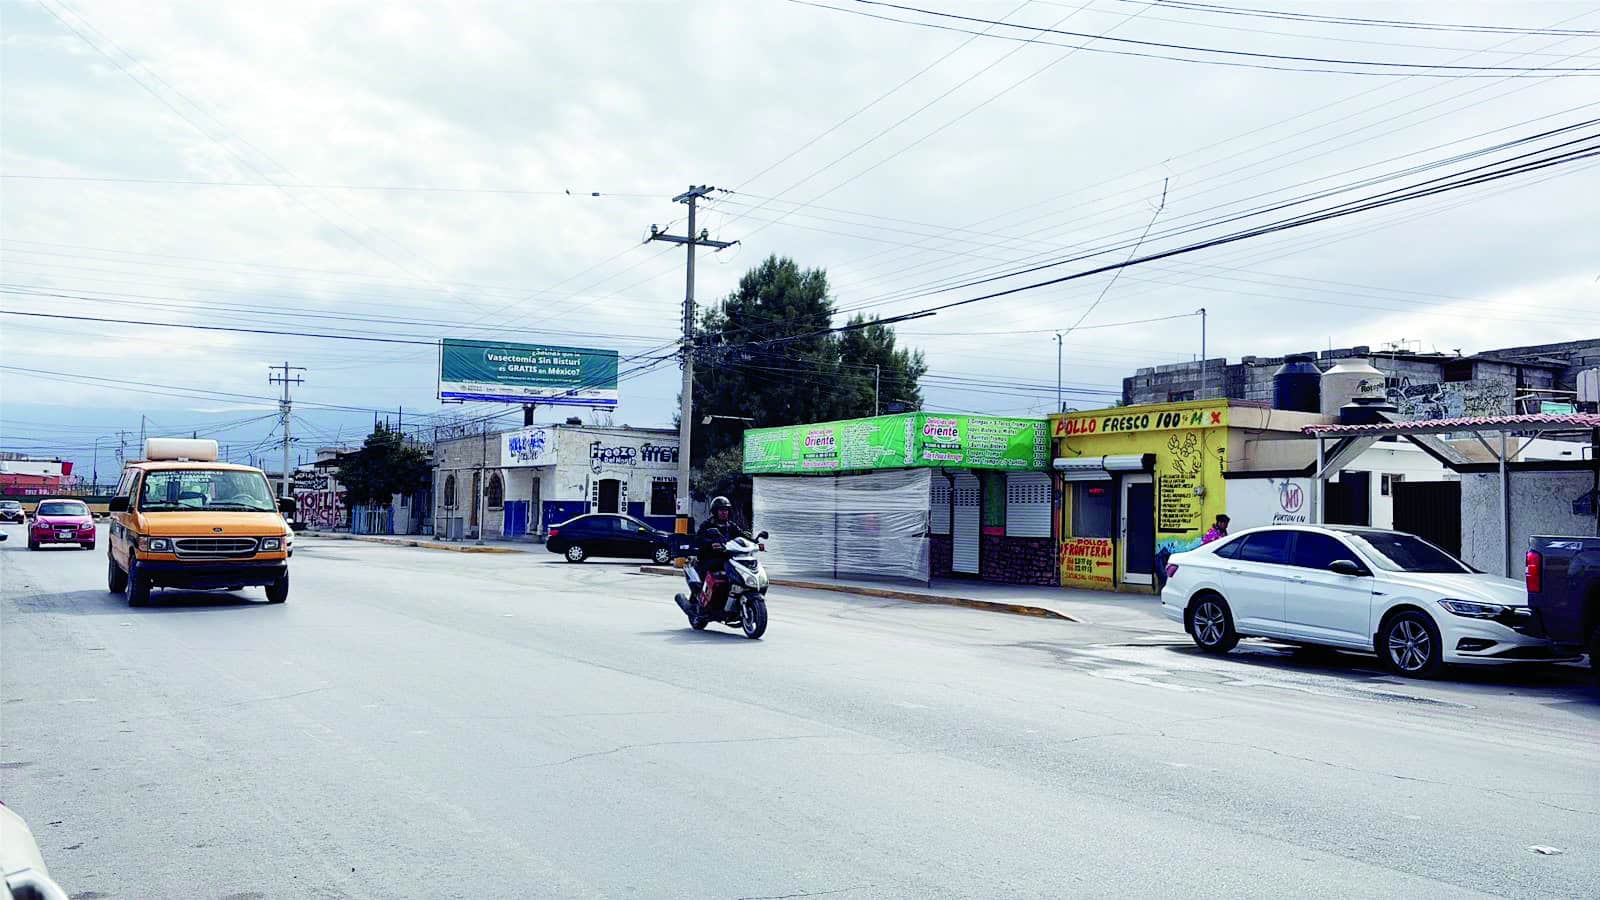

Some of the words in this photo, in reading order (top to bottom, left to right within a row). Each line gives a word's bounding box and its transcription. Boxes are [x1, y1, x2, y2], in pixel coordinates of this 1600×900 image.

[487, 353, 537, 364] Vasectomía
[538, 357, 552, 365] Sin
[553, 358, 581, 366] Bisturí
[507, 364, 538, 373] GRATIS
[548, 366, 580, 376] México?
[924, 424, 958, 437] Oriente
[1056, 419, 1097, 436] POLLO
[1102, 415, 1150, 432] FRESCO
[805, 436, 835, 447] Oriente
[590, 442, 637, 459] Freeze
[642, 443, 680, 463] HIEL
[616, 457, 637, 466] Norte
[1285, 488, 1299, 509] NO
